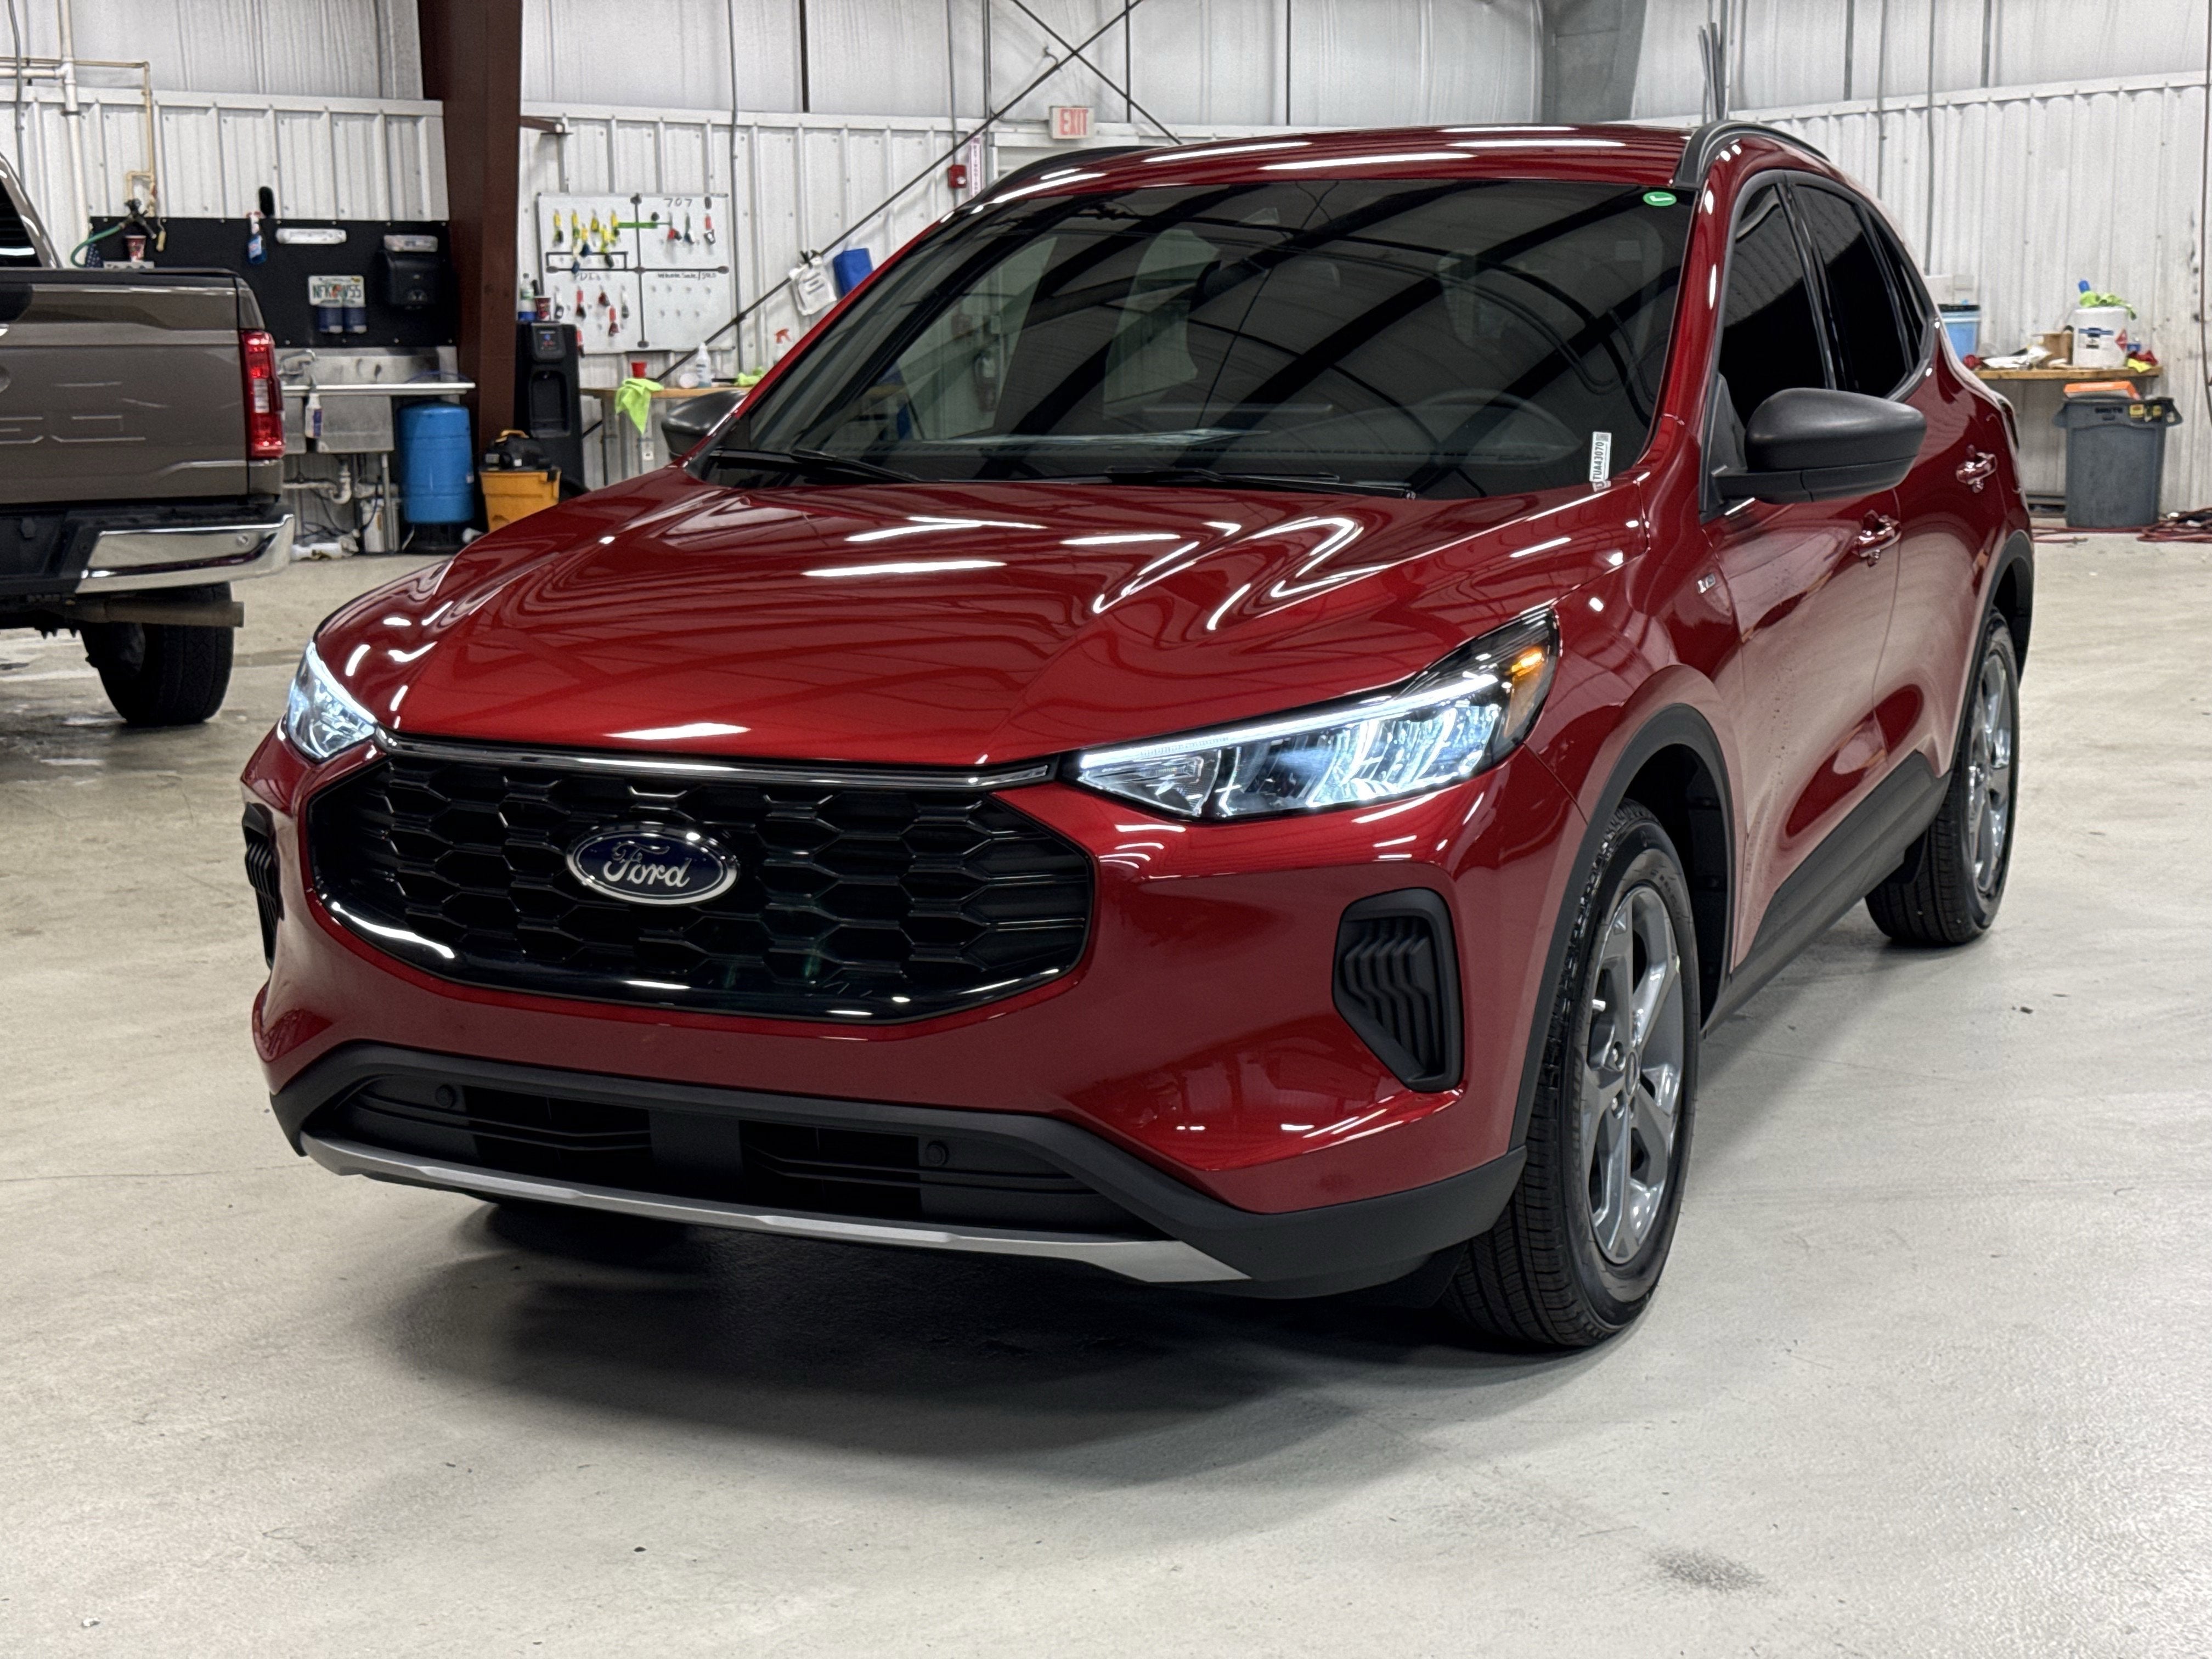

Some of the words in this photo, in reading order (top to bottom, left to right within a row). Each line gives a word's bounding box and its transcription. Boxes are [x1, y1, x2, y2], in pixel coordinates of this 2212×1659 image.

[1059, 108, 1089, 136] EXIT
[663, 198, 693, 207] 707
[1593, 441, 1605, 480] TUA43070
[603, 840, 693, 888] Ford
